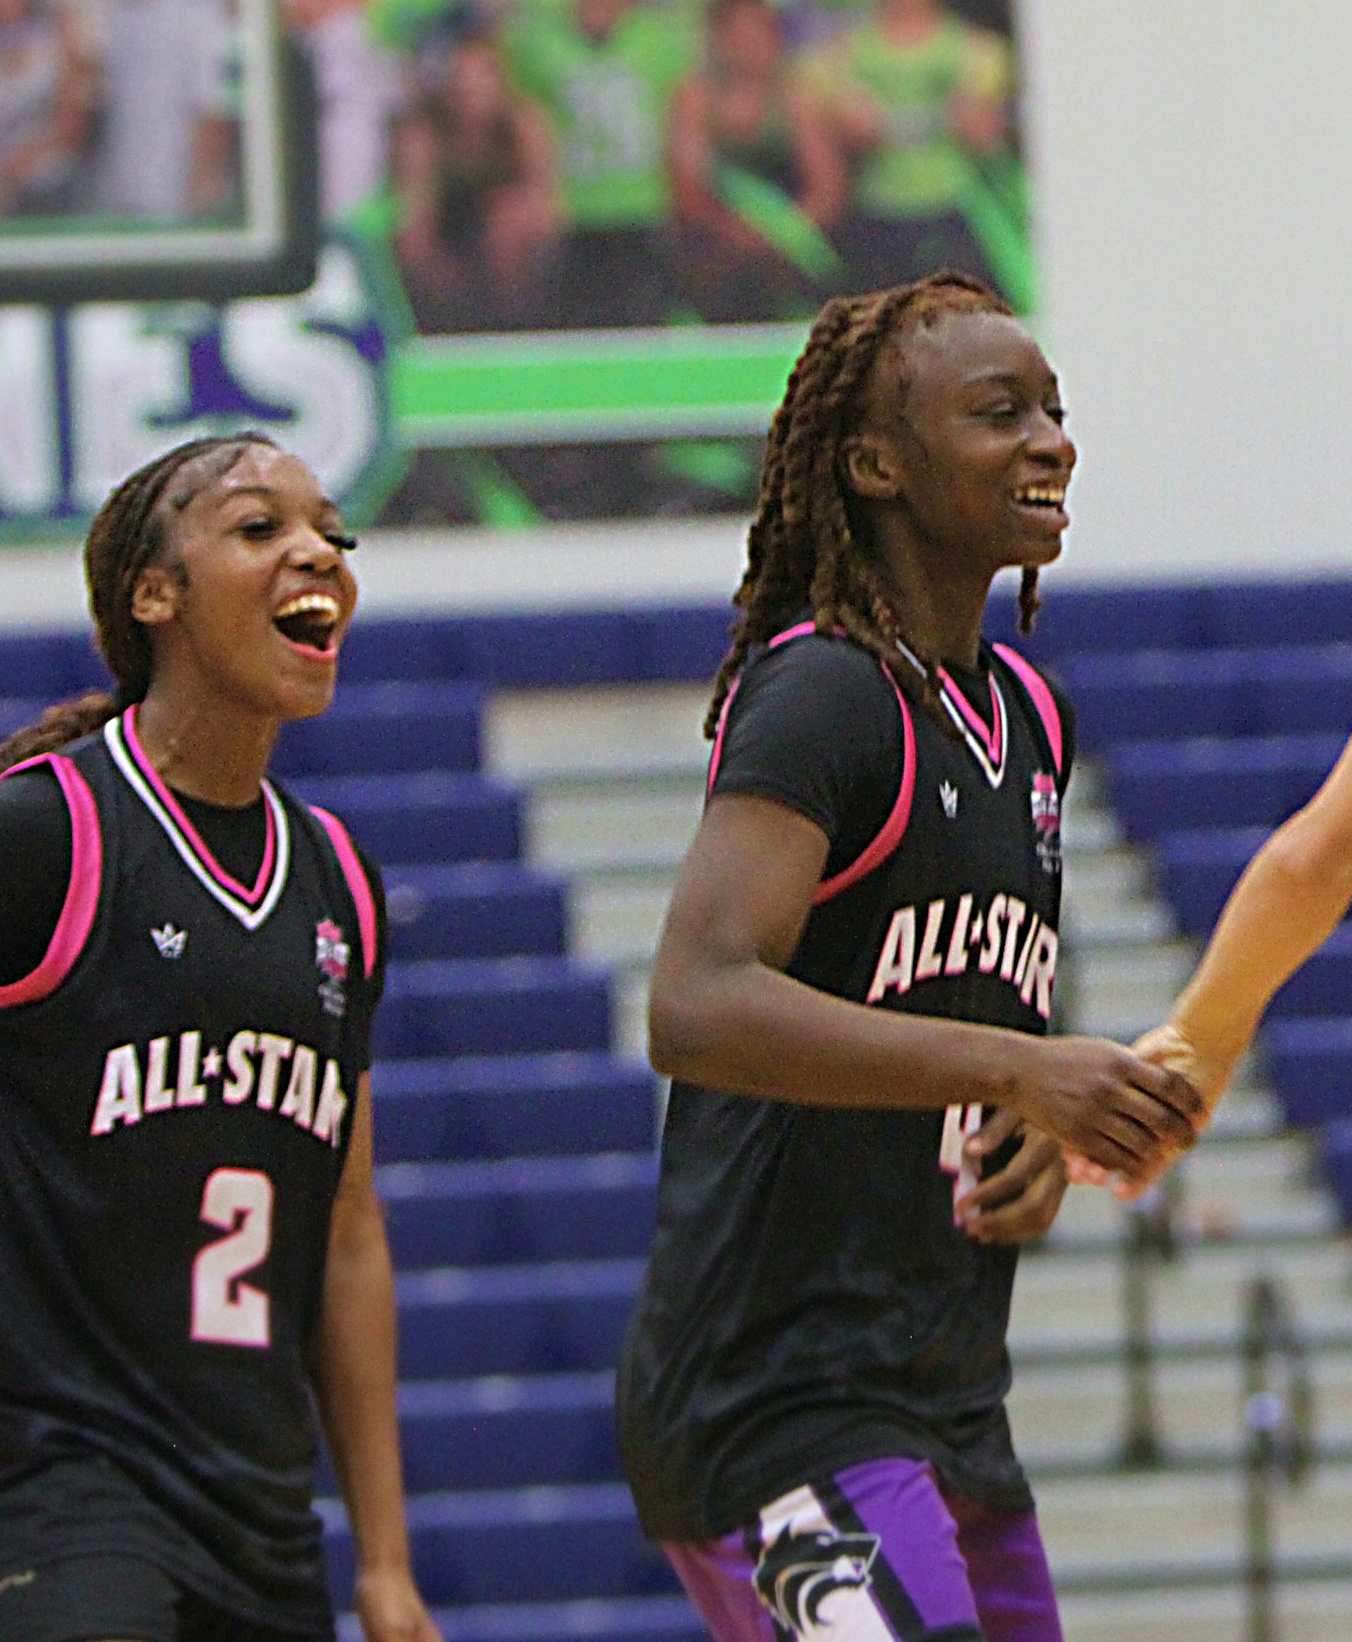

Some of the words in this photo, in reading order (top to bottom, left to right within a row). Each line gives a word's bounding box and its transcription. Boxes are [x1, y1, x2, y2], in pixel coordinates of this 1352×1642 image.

[867, 893, 973, 1006] ALL
[91, 1030, 206, 1136] ALL
[190, 1166, 273, 1347] 2
